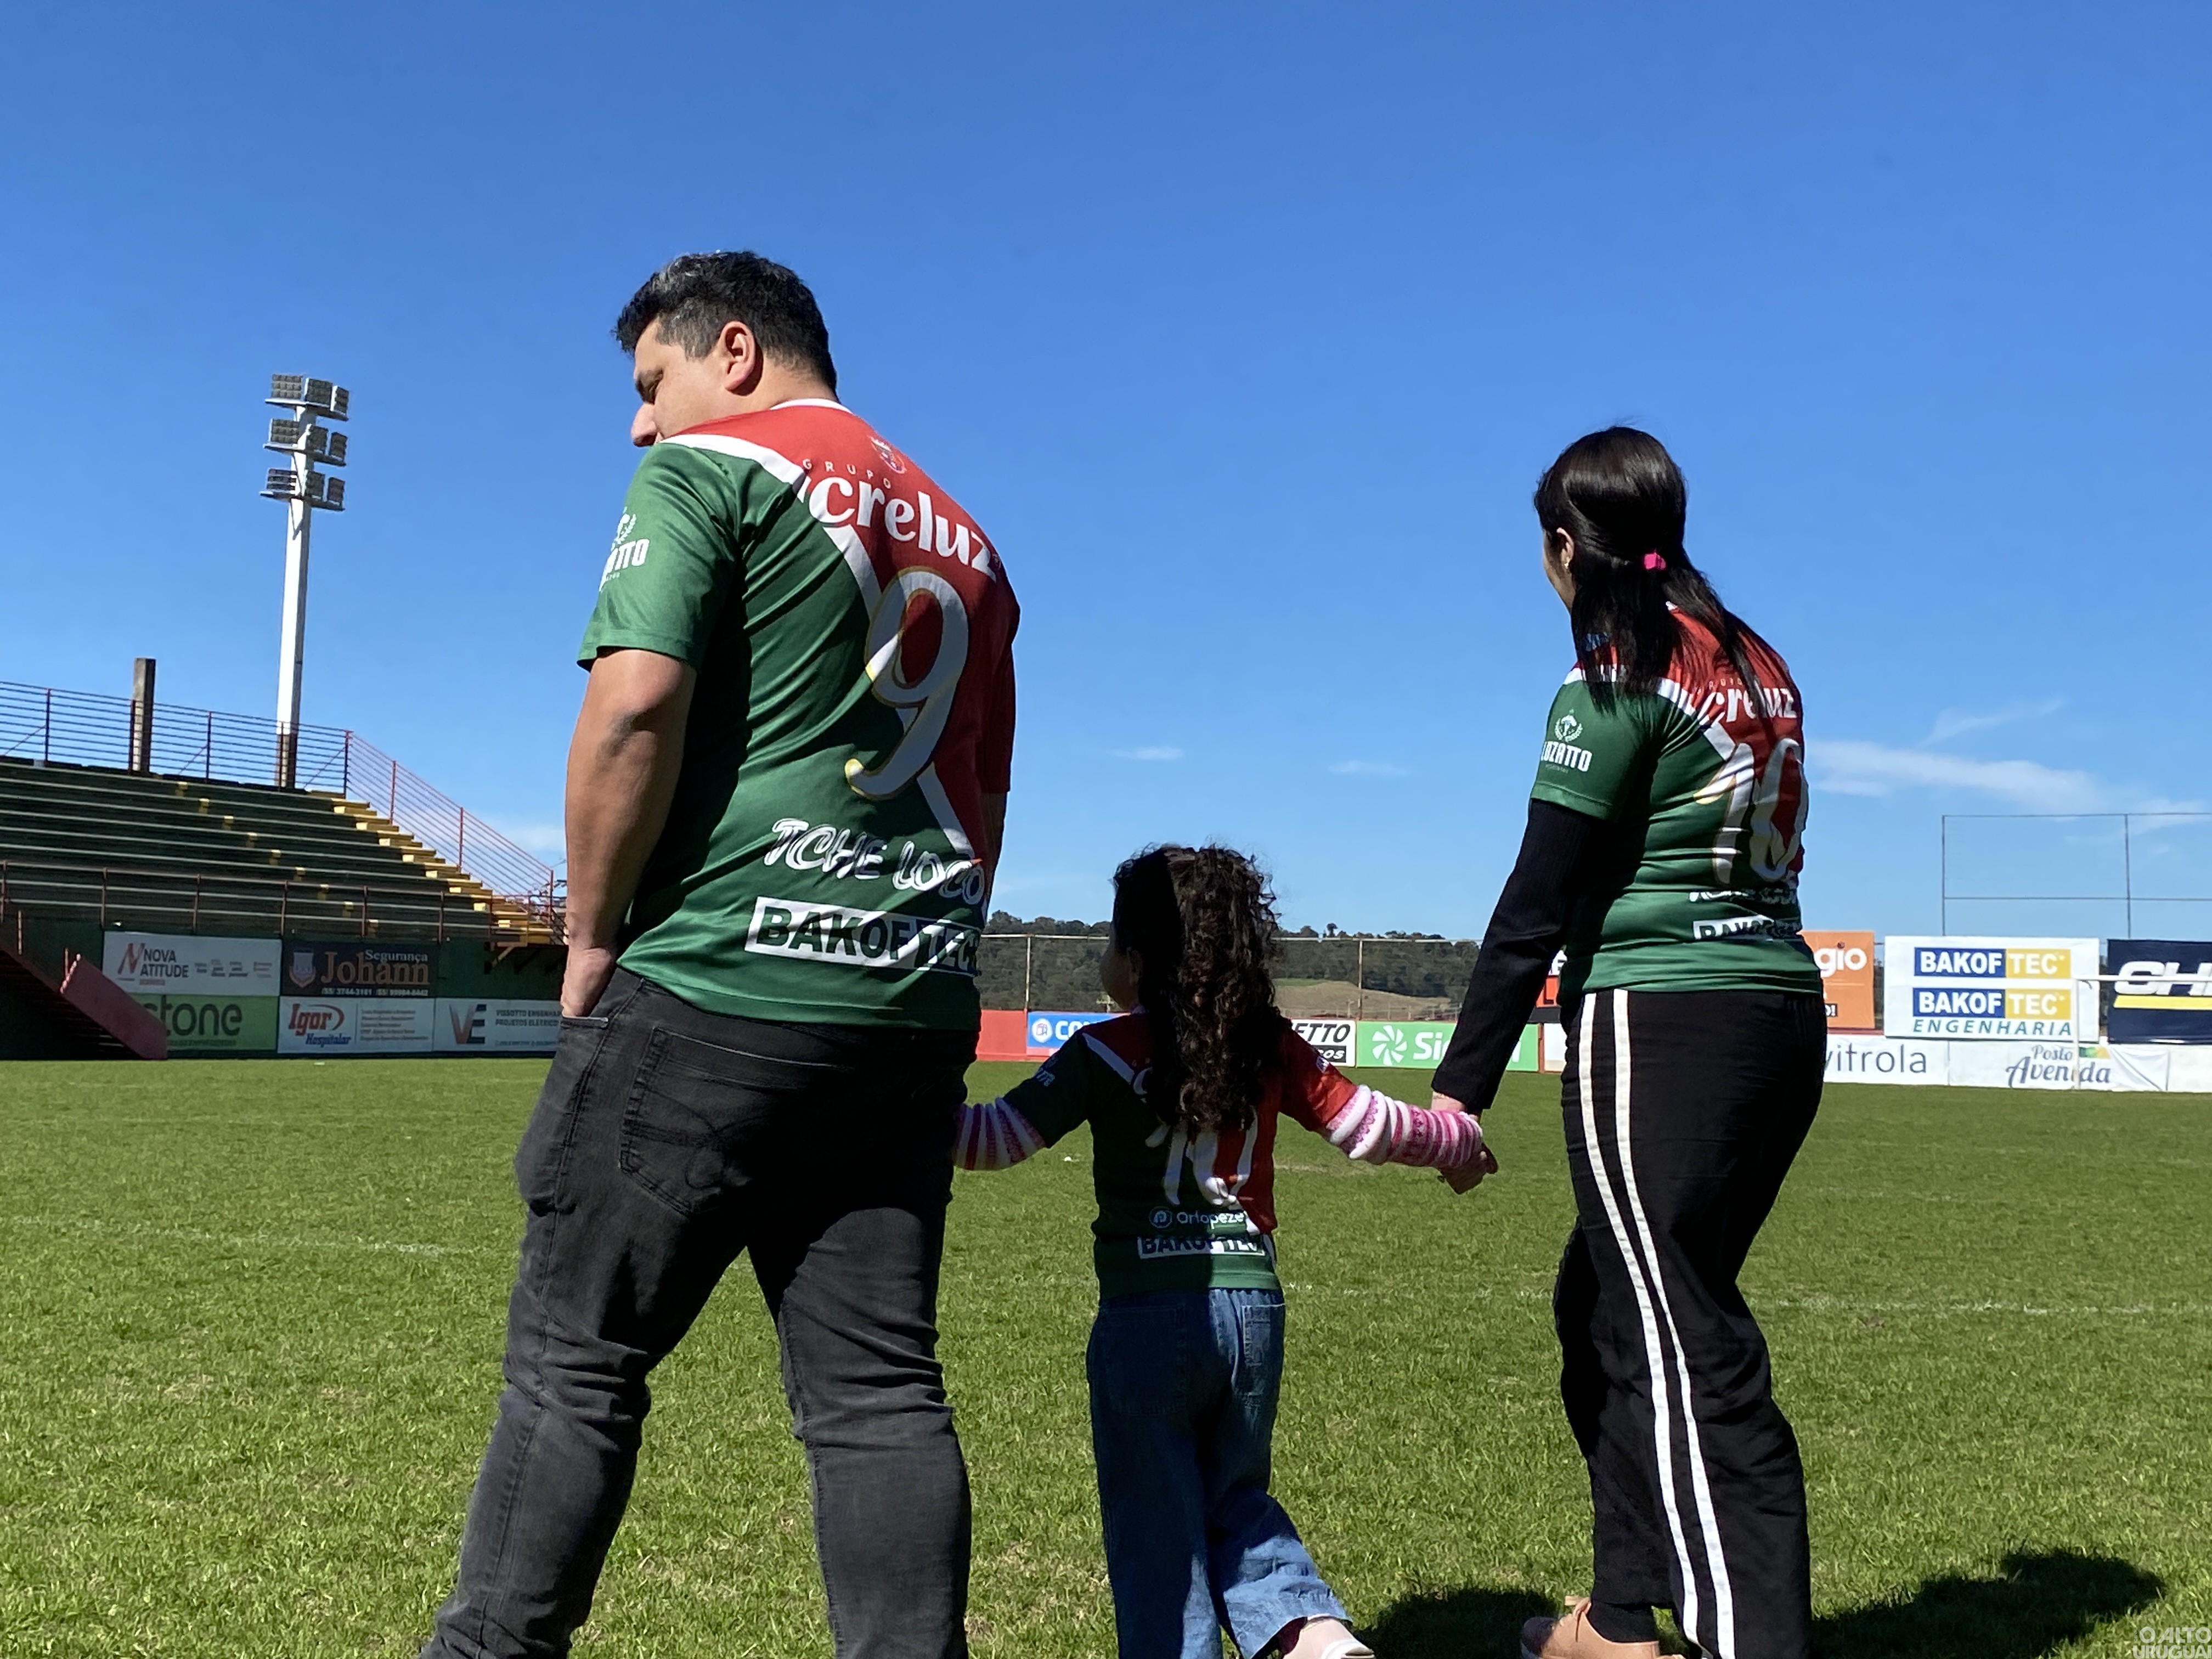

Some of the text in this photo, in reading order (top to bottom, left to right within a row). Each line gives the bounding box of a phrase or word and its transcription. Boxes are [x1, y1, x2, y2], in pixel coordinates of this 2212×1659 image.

[803, 458, 891, 489] GRUPO
[845, 566, 969, 800] 9
[1693, 737, 1809, 884] 10
[764, 818, 985, 905] TCHE LOCO
[143, 949, 177, 963] NOVA
[321, 951, 430, 985] Johann
[365, 949, 428, 963] Segurança
[1920, 951, 2057, 975] BAKOF TEC
[140, 964, 189, 978] ATITUDE
[1919, 991, 2057, 1015] BAKOF TEC
[288, 1003, 332, 1036] Igor
[1913, 1019, 2072, 1036] ENGENHARIA
[1295, 1023, 1351, 1043] ETTO
[2032, 1045, 2073, 1061] Posto
